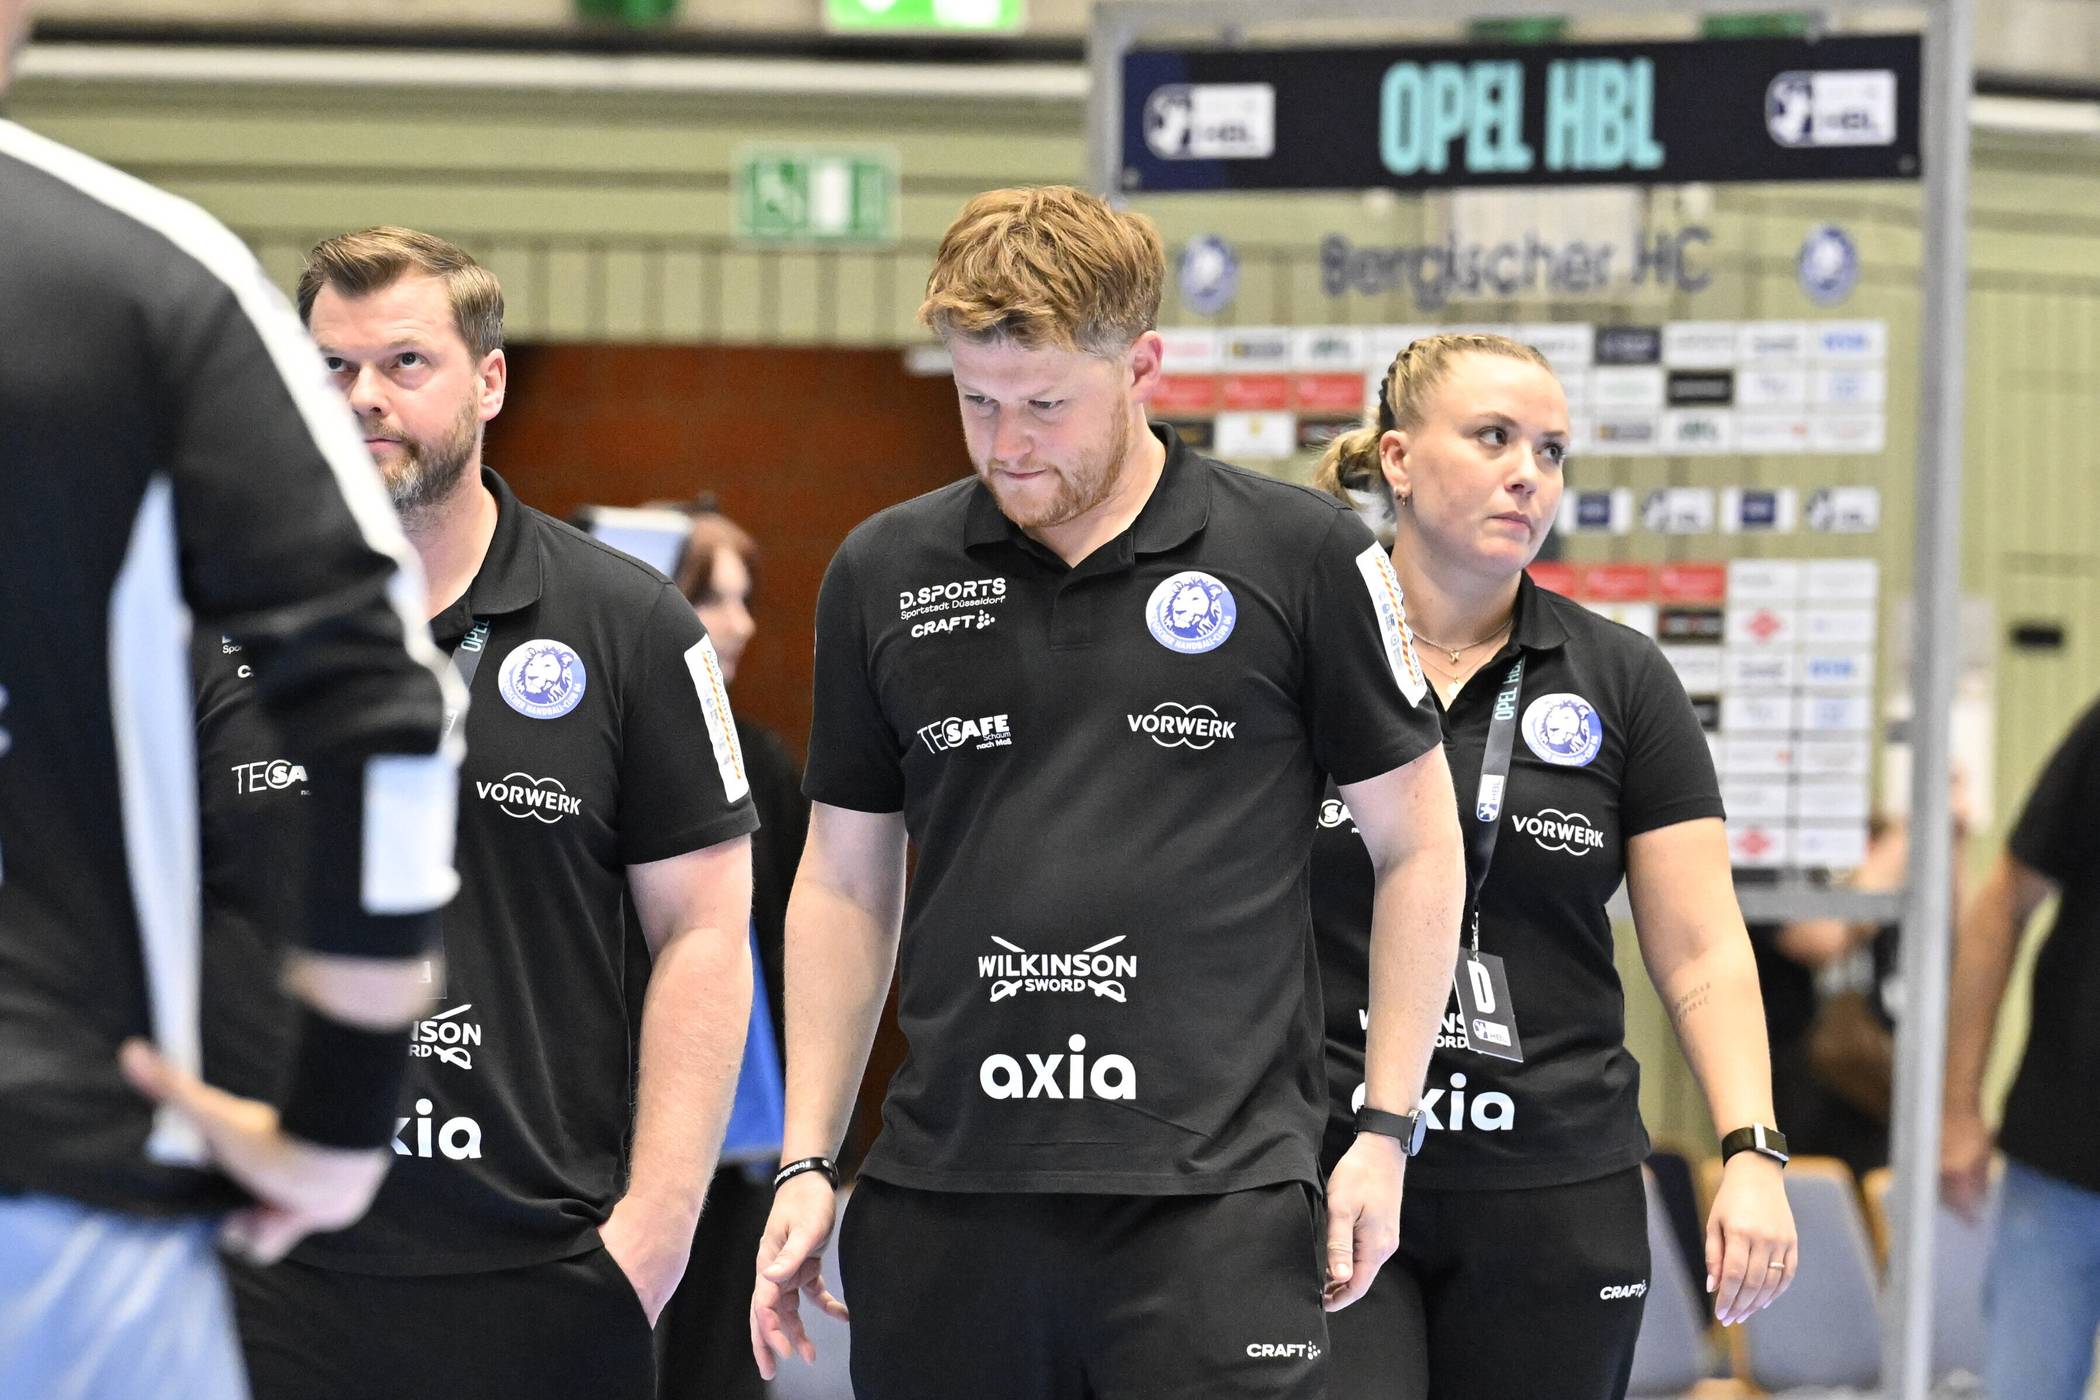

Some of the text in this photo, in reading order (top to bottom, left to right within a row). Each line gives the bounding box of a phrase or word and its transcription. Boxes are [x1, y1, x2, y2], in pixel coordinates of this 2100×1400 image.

[1380, 56, 1666, 174] OPEL HBL
[1320, 225, 1711, 311] Bergischer HC
[900, 577, 1007, 610] D.SPORTS
[900, 595, 1006, 620] Sportstadt Düsseldorf
[911, 615, 976, 638] CRAFT
[1494, 686, 1518, 720] OPEL
[1127, 714, 1237, 739] VORWERK
[476, 781, 582, 816] VORWERK
[1511, 814, 1604, 848] VORWERK
[977, 954, 1138, 978] WILKINSON
[1024, 979, 1086, 992] SWORD
[1467, 960, 1496, 1014] D
[1434, 1035, 1468, 1049] ORD
[979, 1033, 1137, 1100] axia
[390, 1098, 482, 1160] xia
[1600, 1283, 1642, 1300] CRAFT
[1246, 1343, 1307, 1358] CRAFT
